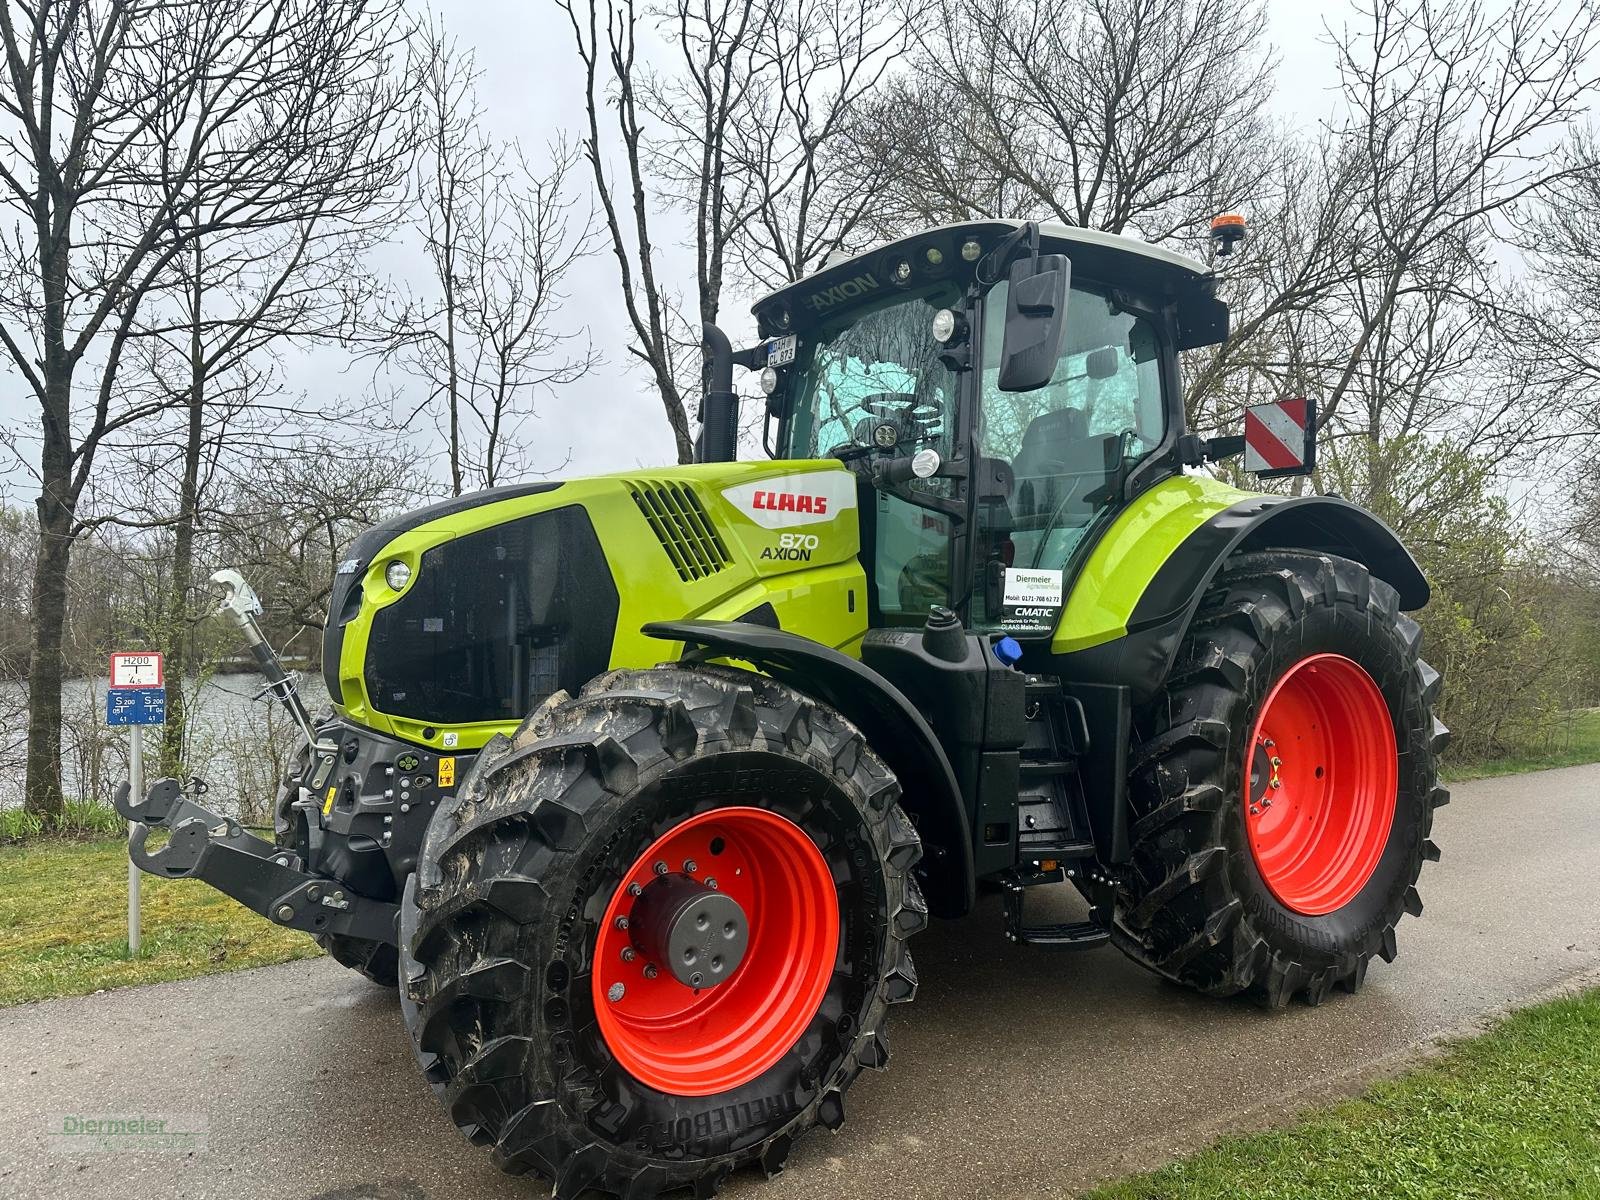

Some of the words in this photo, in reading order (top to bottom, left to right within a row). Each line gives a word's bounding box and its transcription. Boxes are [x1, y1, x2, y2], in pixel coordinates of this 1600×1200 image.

[807, 272, 880, 310] AXION
[769, 354, 778, 366] CL
[779, 348, 793, 362] 873
[752, 490, 828, 515] CLAAS
[778, 533, 820, 550] 870
[760, 547, 813, 562] AXION
[1016, 574, 1052, 584] Diermeier
[1014, 607, 1054, 617] CMATIC
[123, 656, 149, 665] H200
[115, 696, 123, 705] S
[144, 696, 152, 705] S
